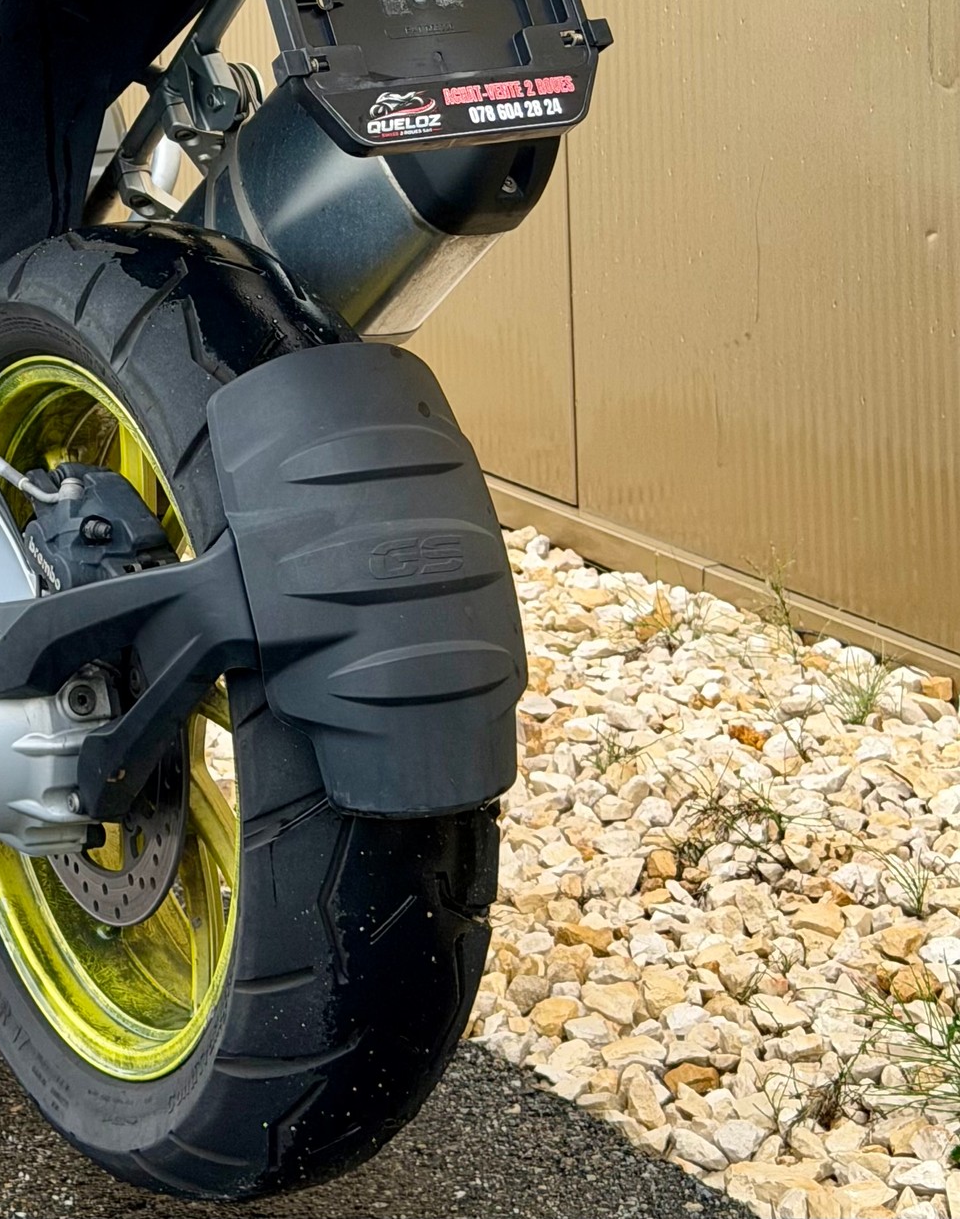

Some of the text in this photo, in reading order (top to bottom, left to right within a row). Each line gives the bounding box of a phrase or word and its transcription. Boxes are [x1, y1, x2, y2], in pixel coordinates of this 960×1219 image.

[443, 75, 575, 106] ACHAT-VENTE 2 ROUES
[367, 113, 441, 134] QUELOZ
[468, 97, 563, 124] 078 604 28 24
[28, 535, 61, 591] brembo
[368, 535, 464, 580] GS
